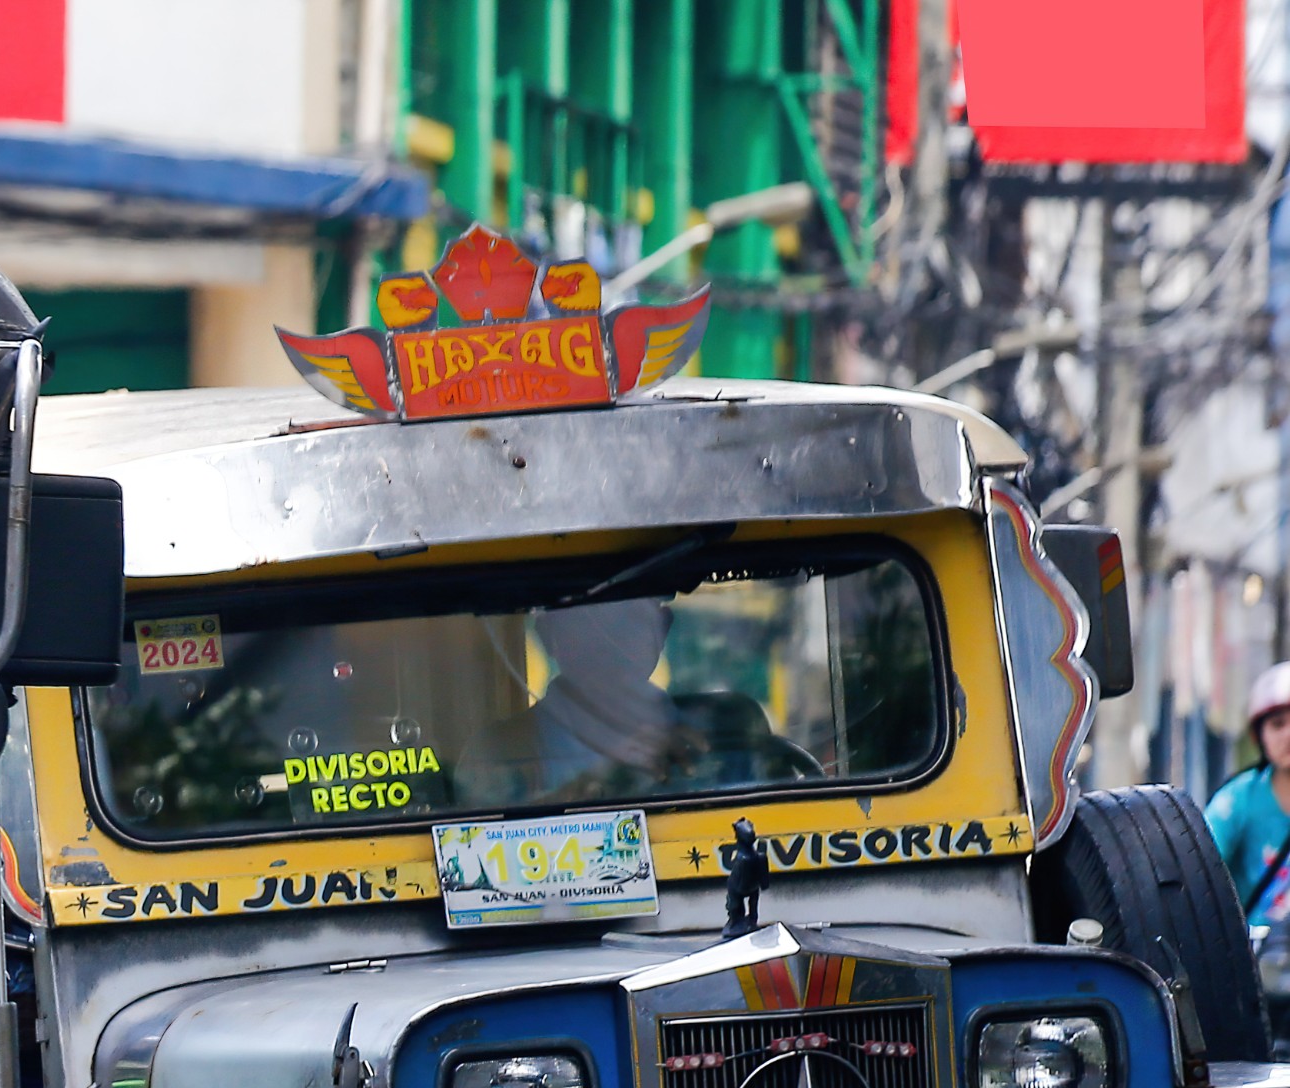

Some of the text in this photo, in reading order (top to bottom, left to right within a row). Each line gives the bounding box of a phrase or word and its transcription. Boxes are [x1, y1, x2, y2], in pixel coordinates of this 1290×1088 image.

[402, 321, 601, 395] HAYAG
[143, 637, 218, 668] 2024
[284, 746, 440, 785] DIVISORIA
[311, 781, 411, 813] RECTO
[486, 829, 503, 840] SAN
[506, 828, 526, 839] JUAN
[718, 820, 994, 871] DVISORIA
[486, 837, 586, 884] 194
[101, 881, 219, 919] SAN
[482, 891, 509, 902] SAN
[560, 884, 625, 898] DIVISORIA
